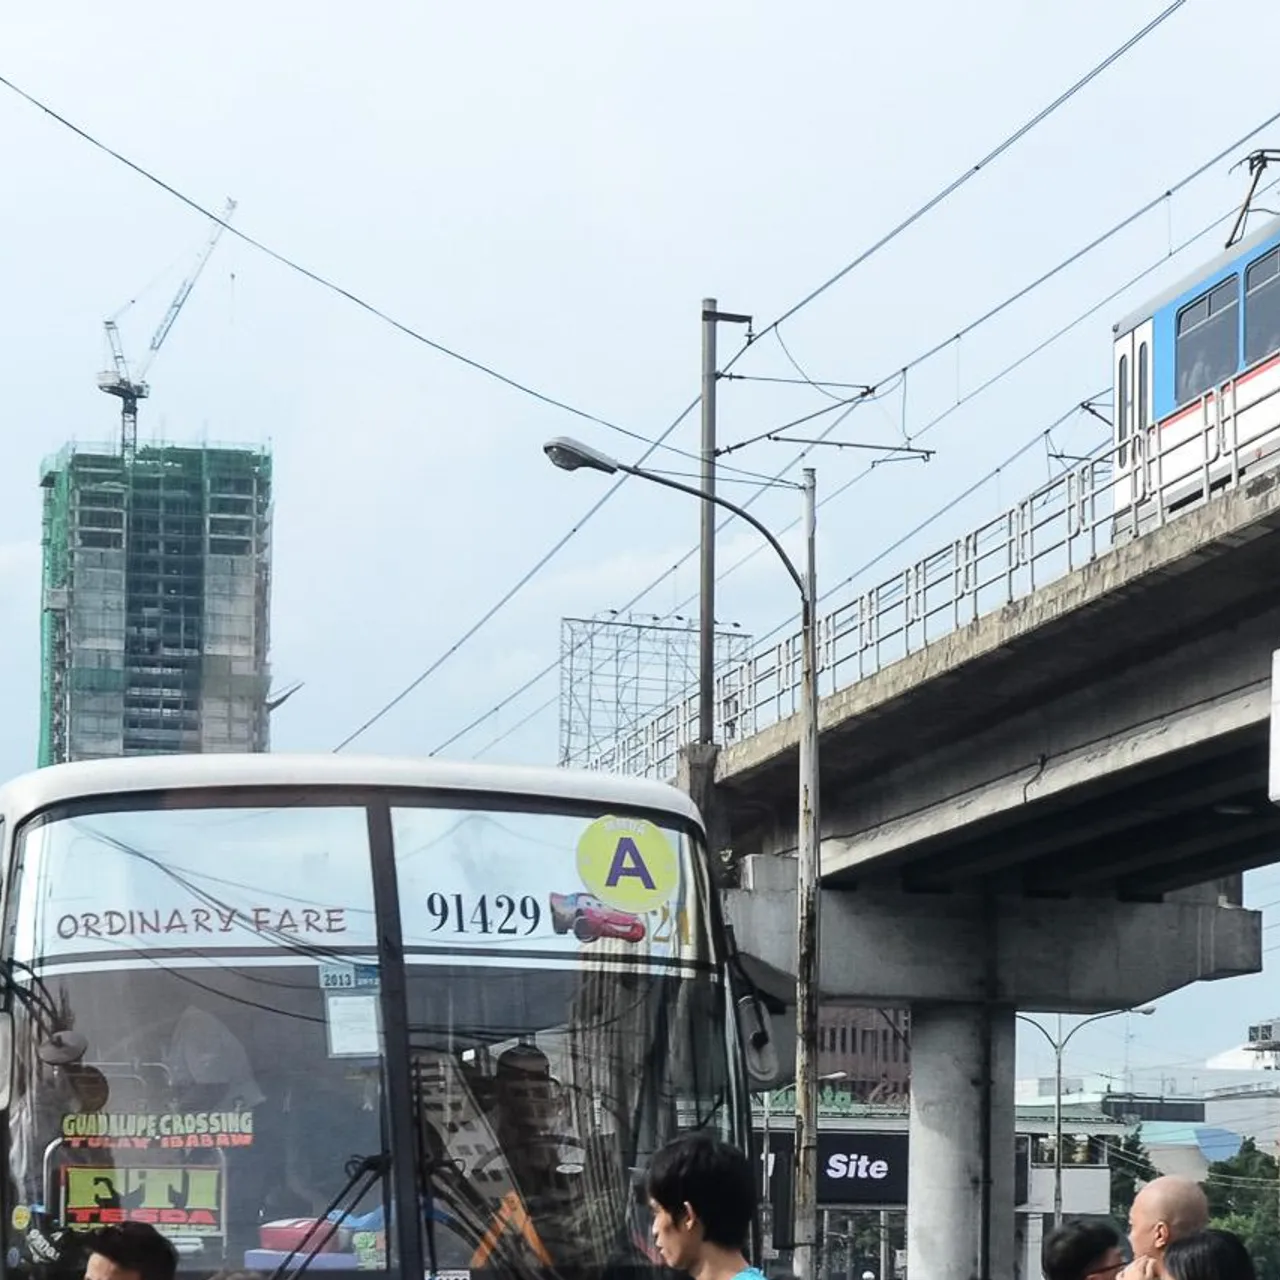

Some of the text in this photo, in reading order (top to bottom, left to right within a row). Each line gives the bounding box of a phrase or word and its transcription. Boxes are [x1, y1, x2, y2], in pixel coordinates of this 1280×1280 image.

[605, 837, 656, 890] A
[57, 906, 349, 939] ORDINARY FARE
[427, 892, 541, 936] 91429
[323, 974, 352, 987] 2013
[160, 1112, 253, 1134] CROSSING
[826, 1153, 889, 1179] Site
[67, 1168, 220, 1210] FTI
[68, 1208, 217, 1224] TESDA
